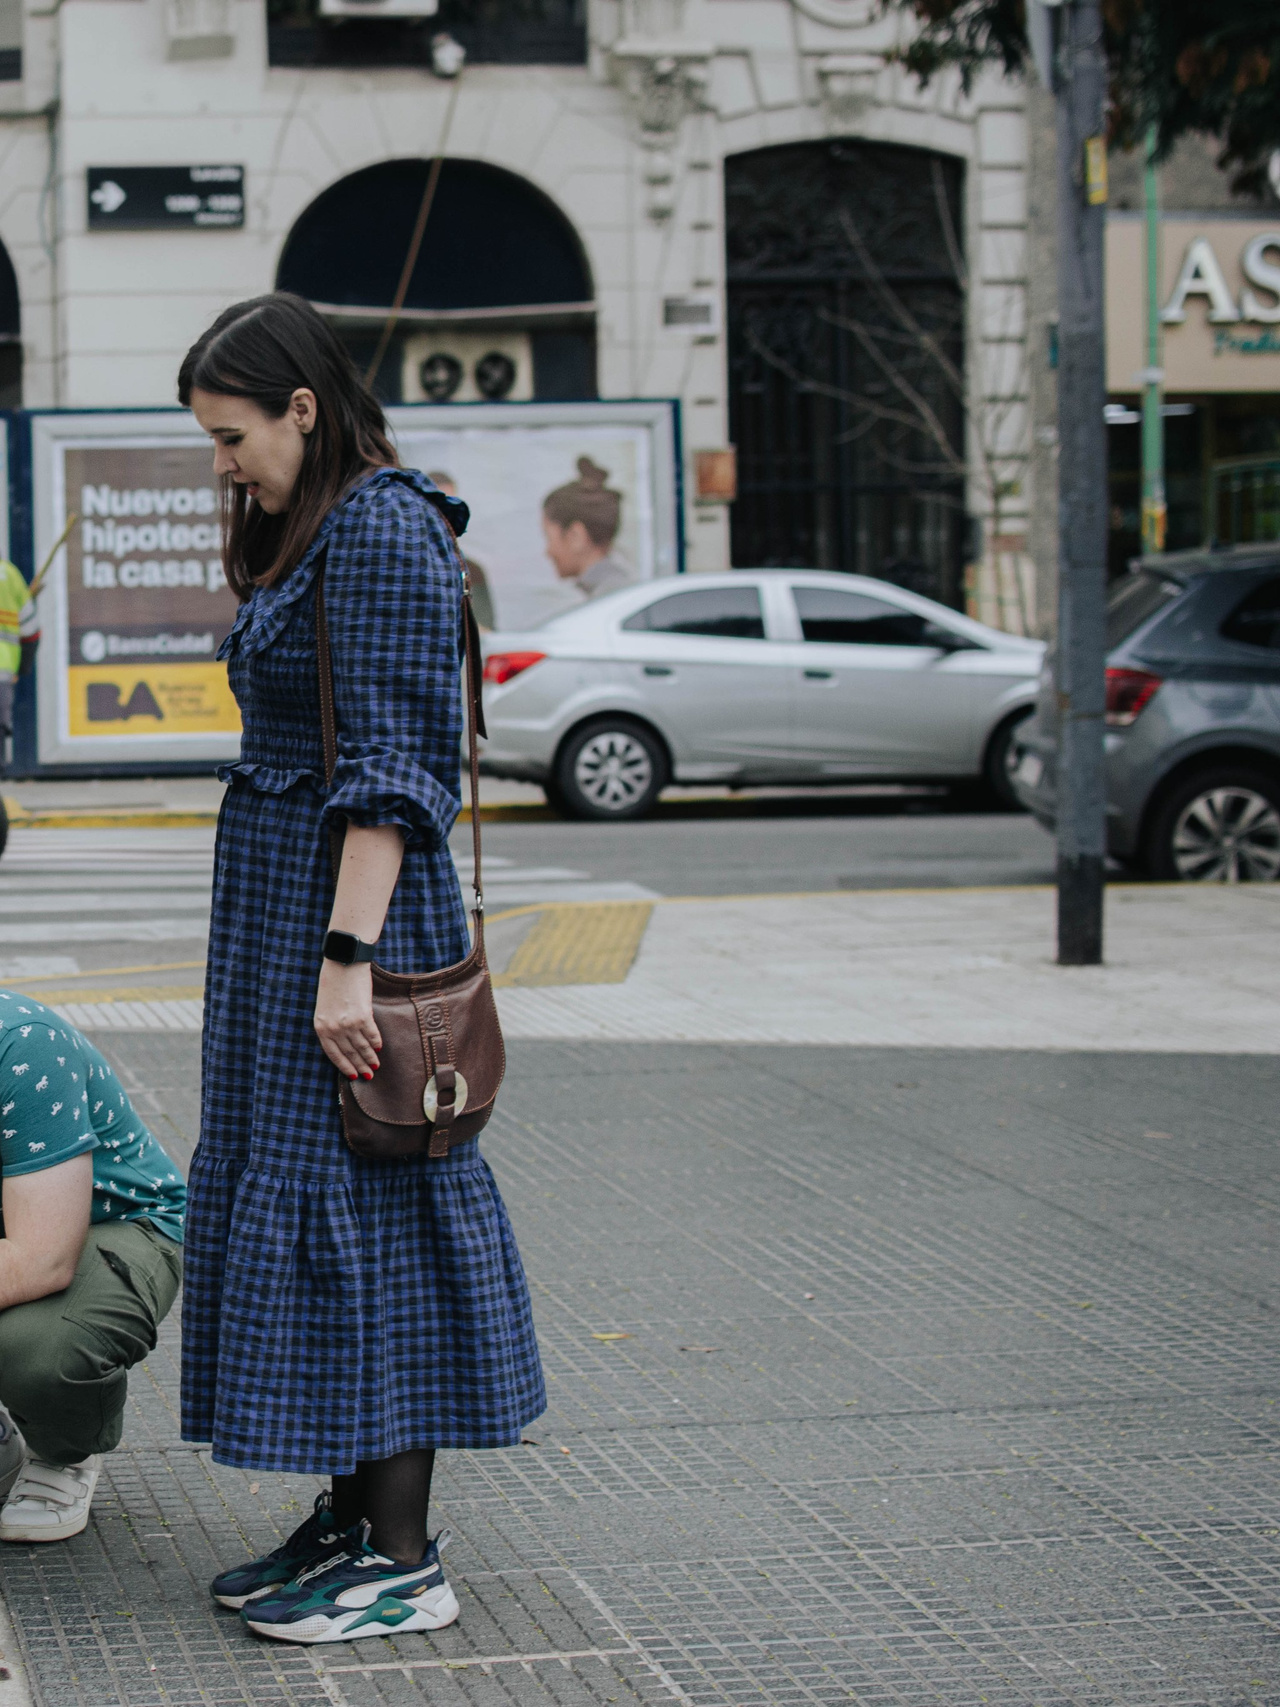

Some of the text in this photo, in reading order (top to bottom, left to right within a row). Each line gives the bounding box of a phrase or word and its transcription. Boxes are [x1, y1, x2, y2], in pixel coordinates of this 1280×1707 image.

[81, 484, 216, 517] Nuevos
[82, 557, 116, 590] la
[119, 563, 200, 590] casa
[86, 681, 164, 721] BA
